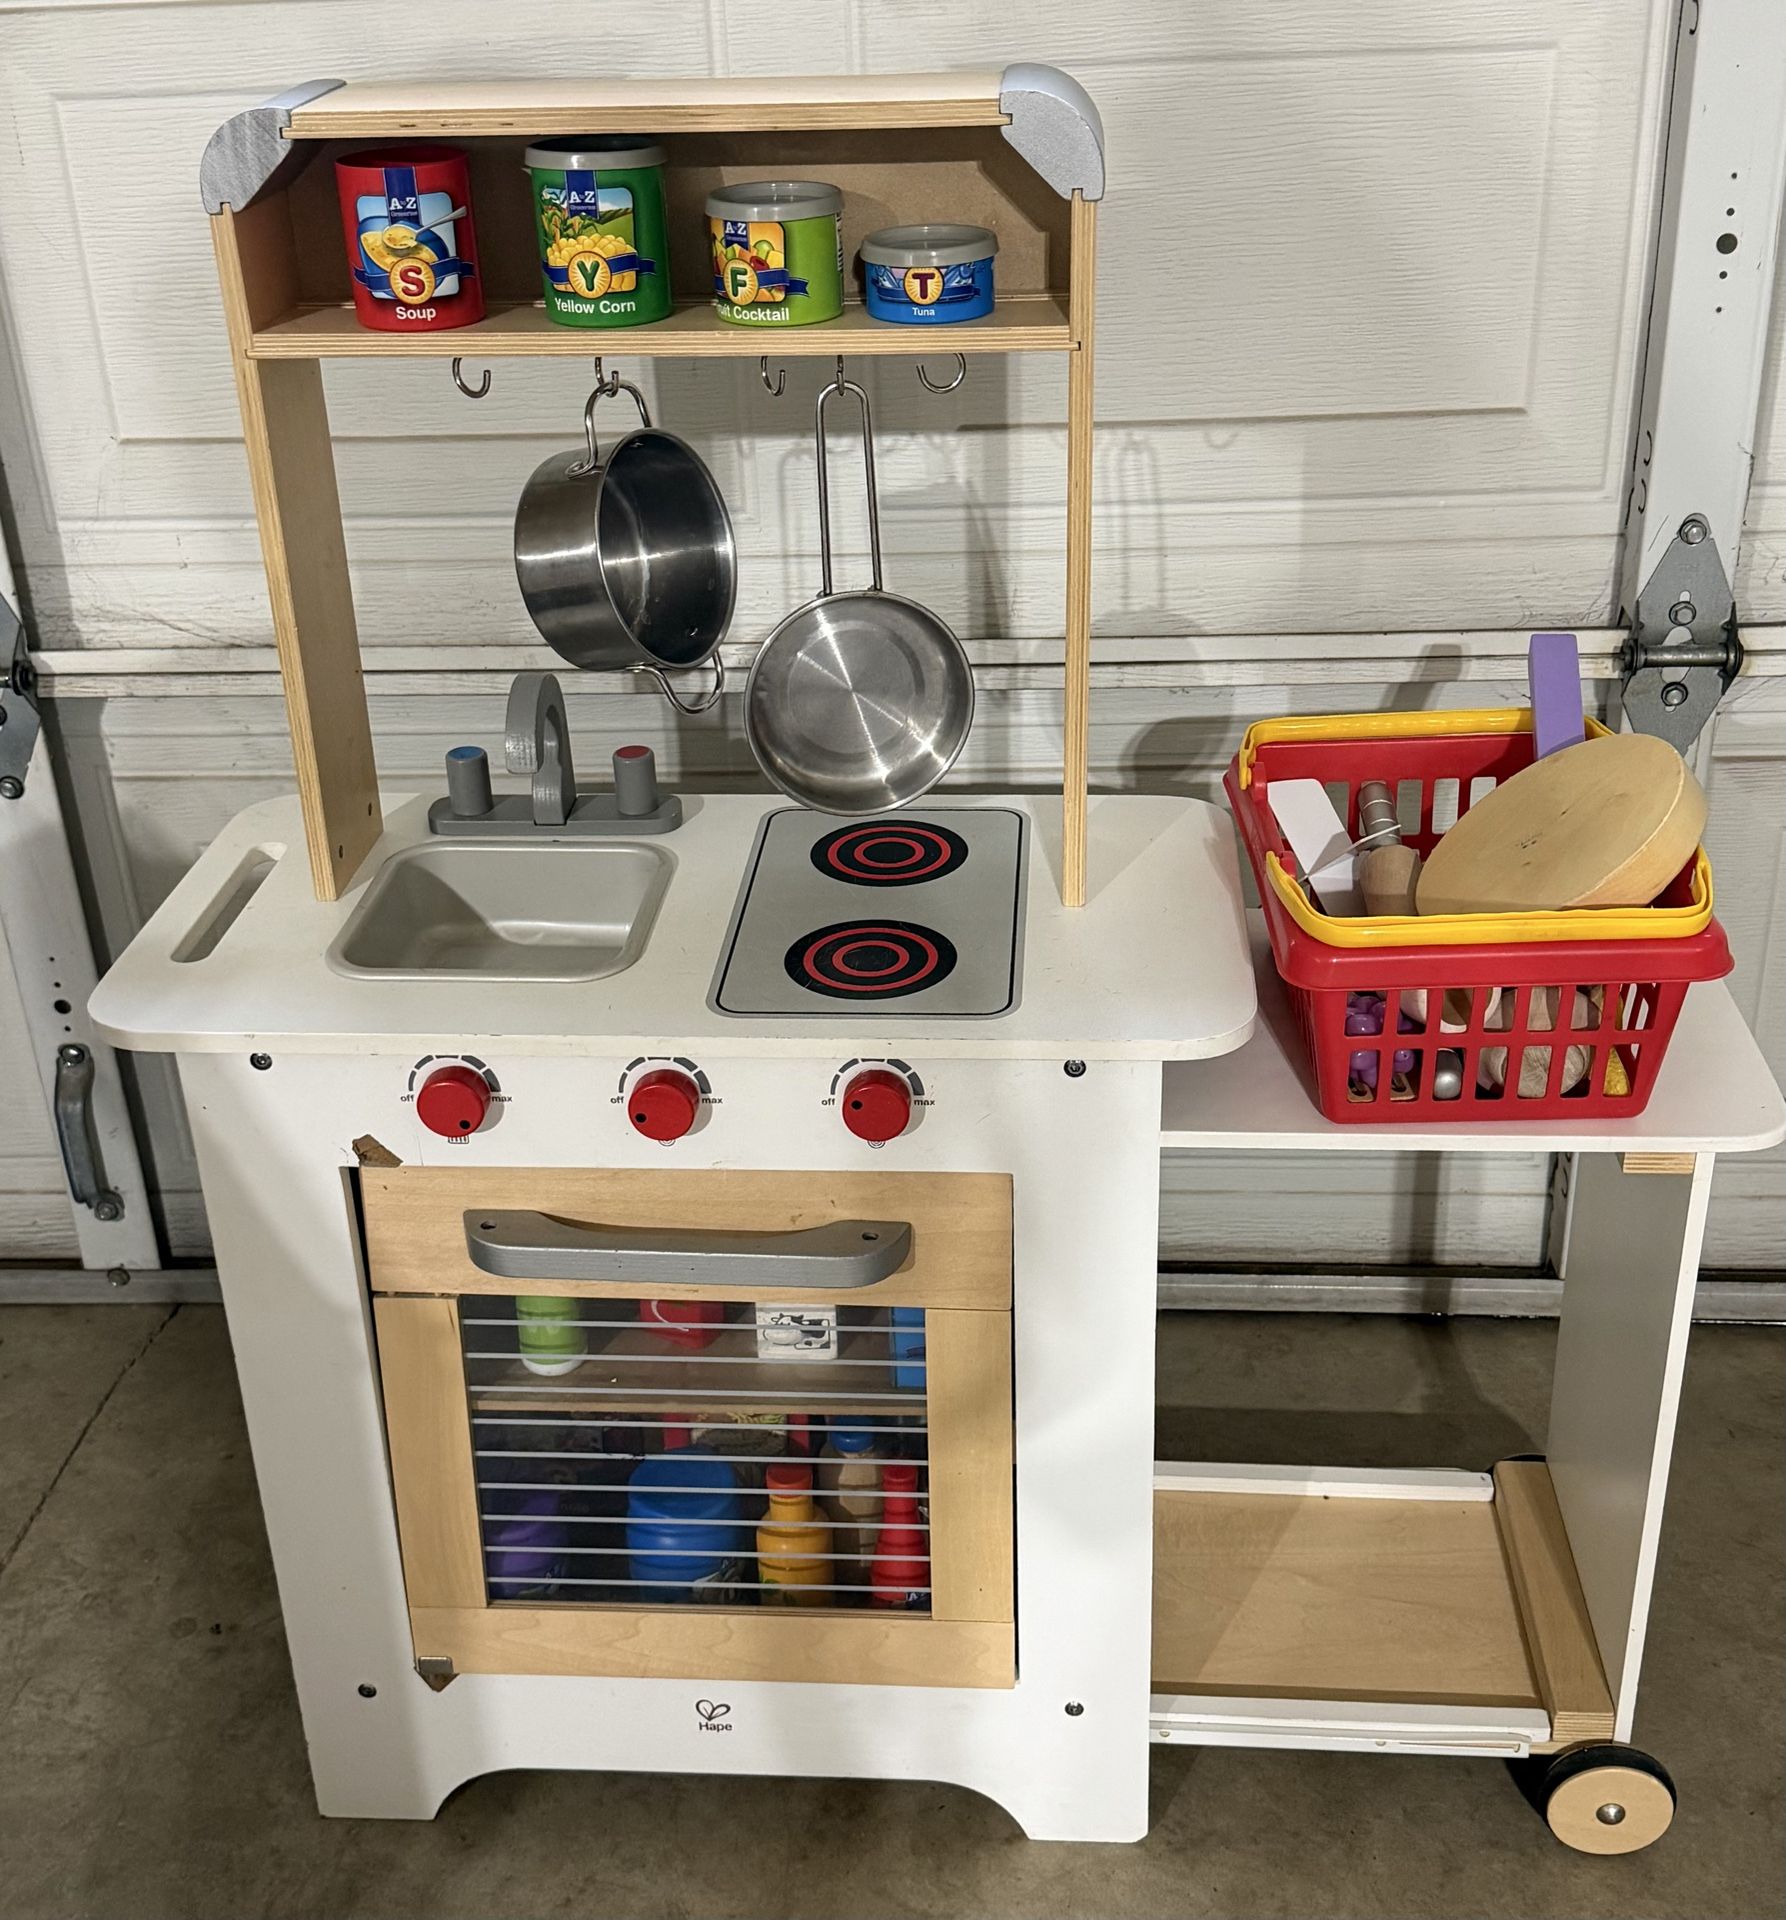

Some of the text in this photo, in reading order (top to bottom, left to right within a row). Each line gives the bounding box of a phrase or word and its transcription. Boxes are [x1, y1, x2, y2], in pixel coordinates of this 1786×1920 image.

[399, 265, 426, 297] S
[577, 260, 600, 292] Y
[730, 266, 747, 298] F
[911, 272, 936, 300] T
[554, 297, 636, 314] Yellow Corn
[911, 307, 936, 316] Tuna
[395, 306, 437, 322] Soup
[733, 305, 790, 321] Cocktail
[400, 1094, 415, 1103] off
[491, 1095, 513, 1103] max
[610, 1096, 625, 1105] off
[701, 1097, 723, 1105] max
[821, 1098, 836, 1106] off
[914, 1099, 936, 1107] max
[698, 1721, 733, 1733] Hape
